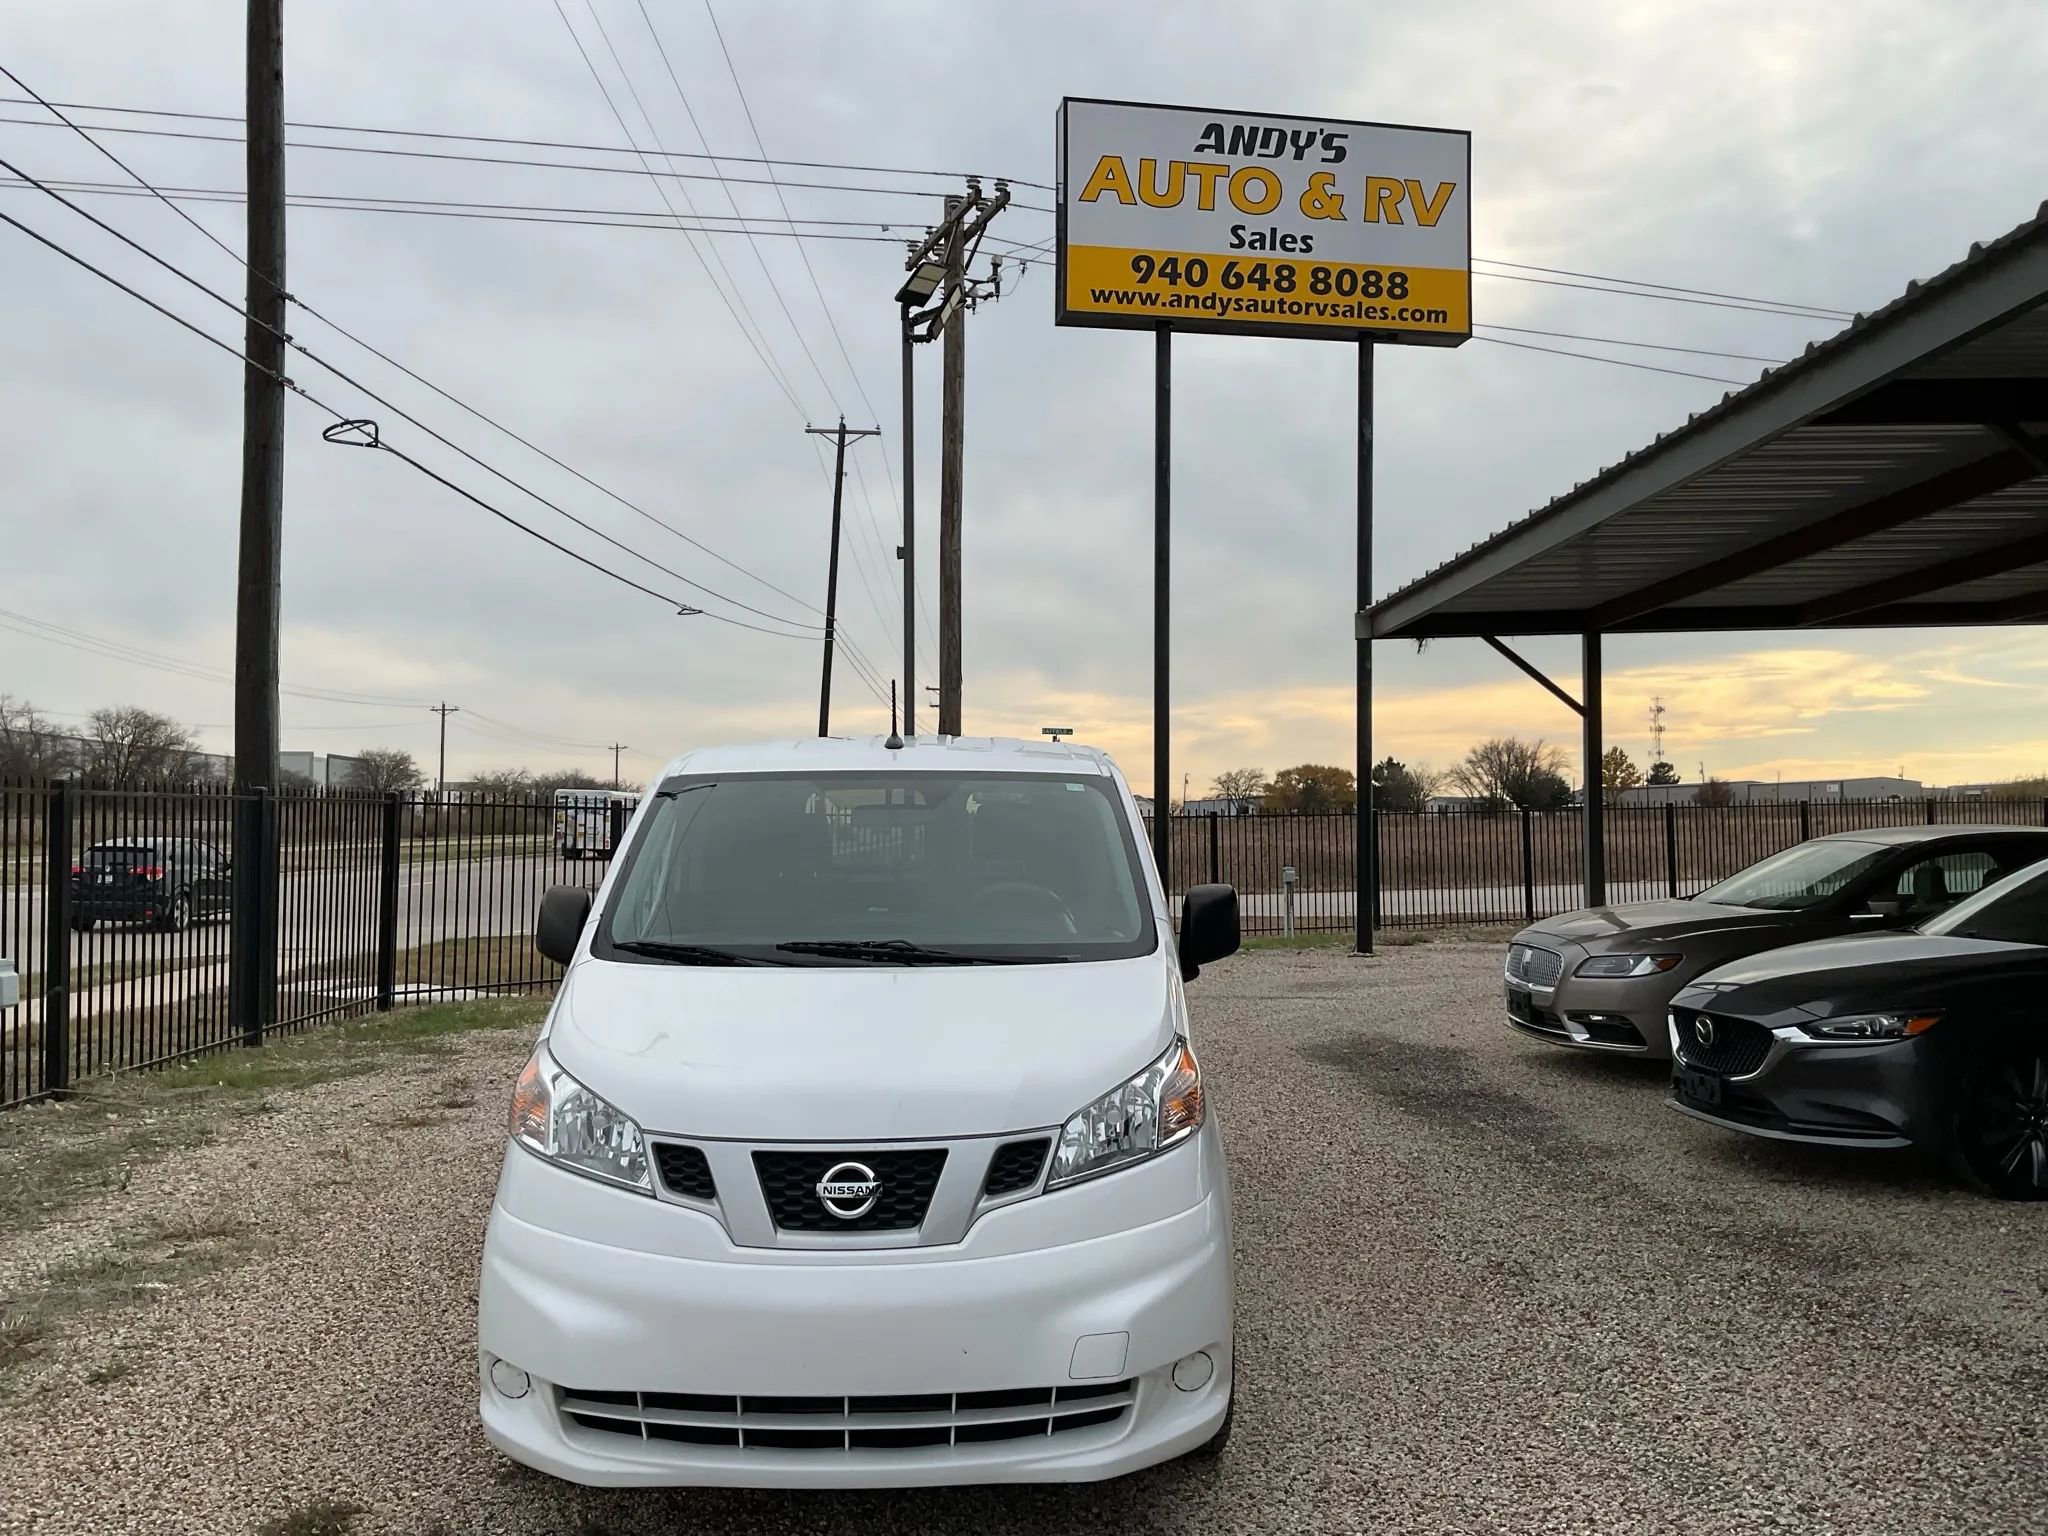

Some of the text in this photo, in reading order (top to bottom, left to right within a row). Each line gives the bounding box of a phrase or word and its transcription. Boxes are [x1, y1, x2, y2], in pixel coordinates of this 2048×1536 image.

[1194, 123, 1349, 163] ANDY'S
[1078, 155, 1457, 227] AUTO & RV
[1229, 224, 1314, 254] Sales
[1131, 255, 1409, 300] 940 648 8088
[1091, 287, 1448, 324] www.andysautorvsales.com
[823, 1186, 875, 1195] NISSAN
